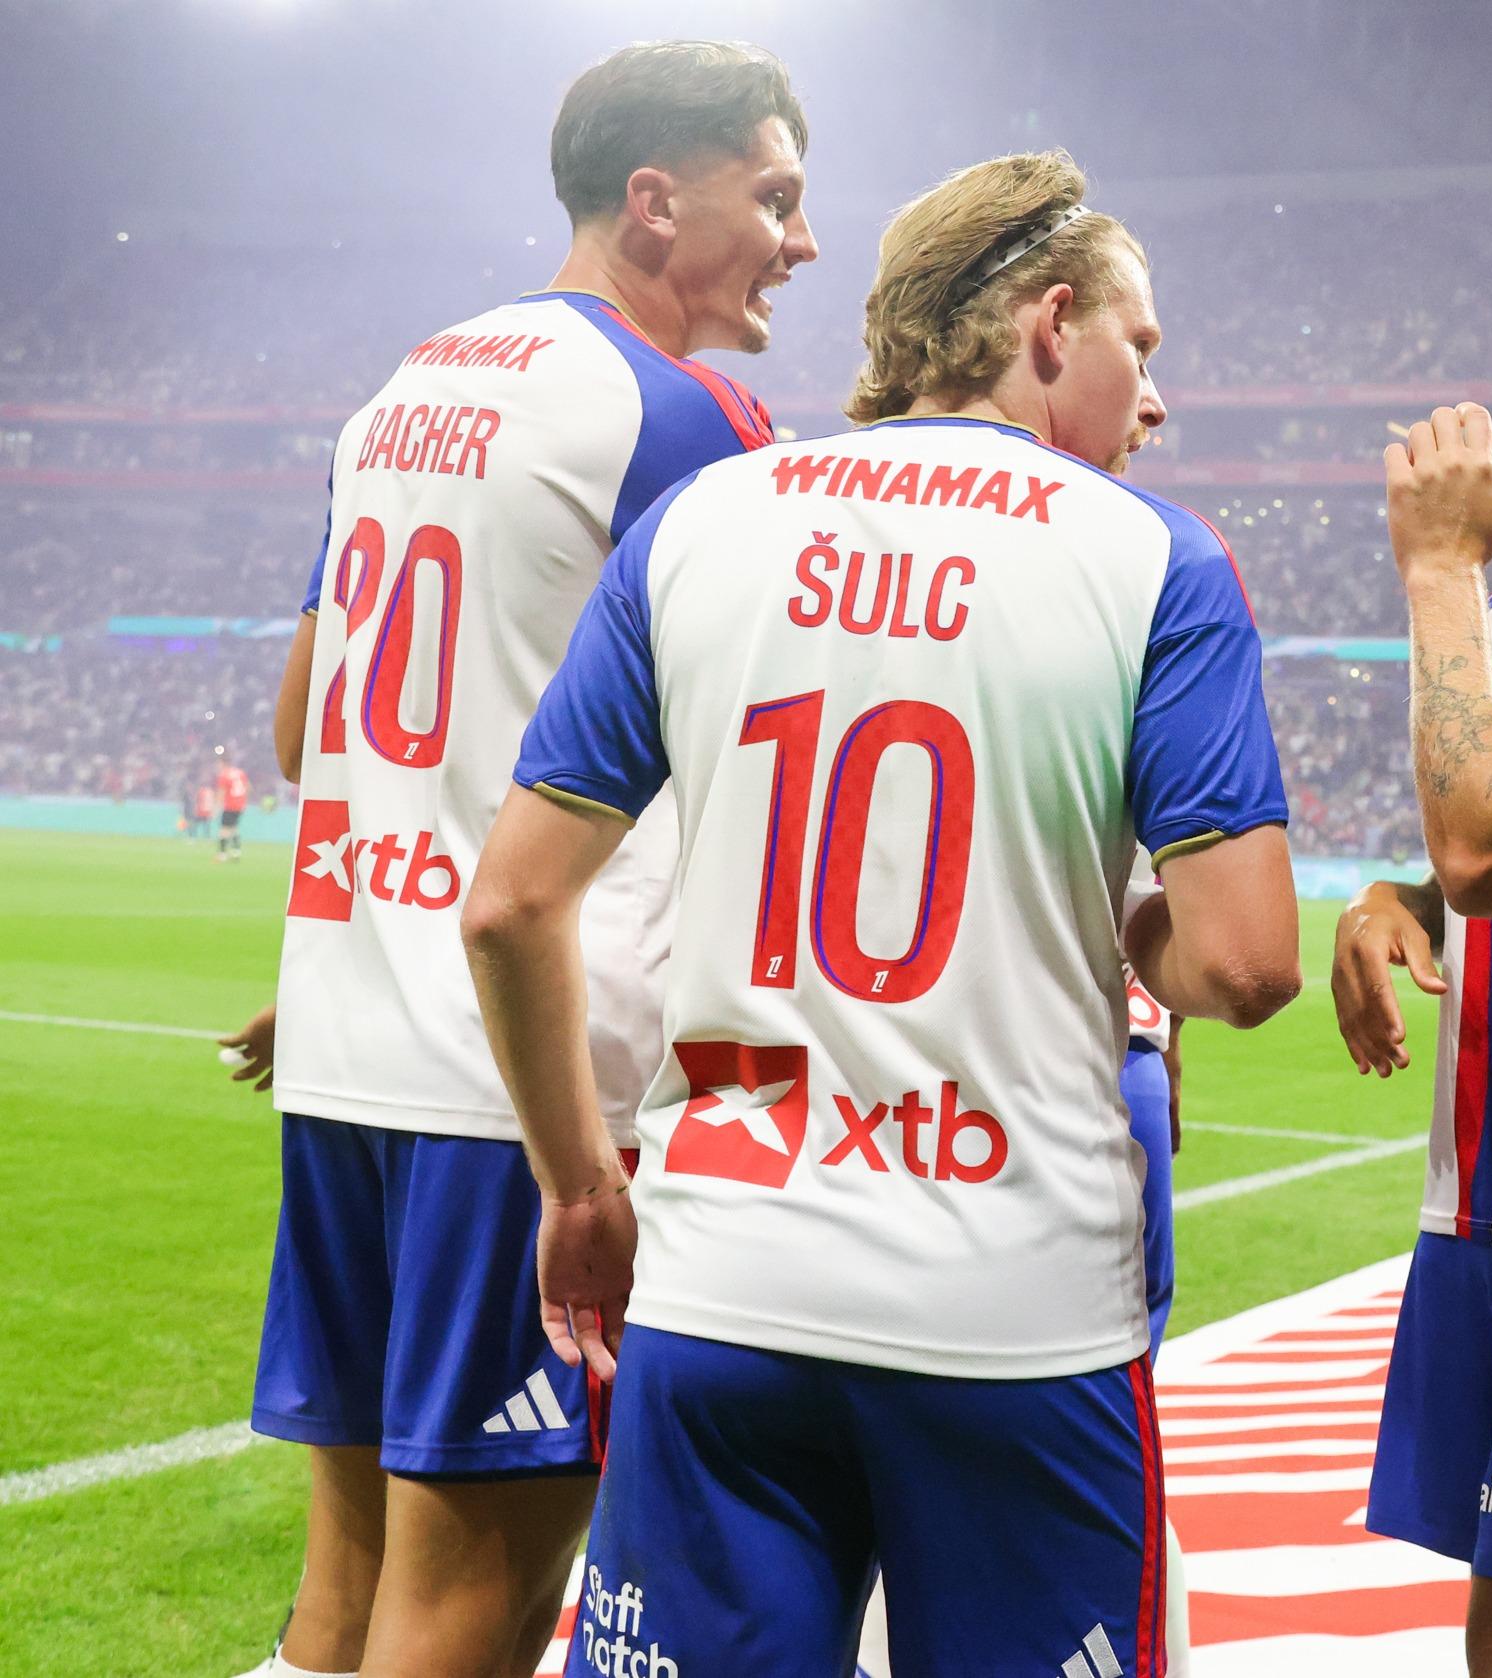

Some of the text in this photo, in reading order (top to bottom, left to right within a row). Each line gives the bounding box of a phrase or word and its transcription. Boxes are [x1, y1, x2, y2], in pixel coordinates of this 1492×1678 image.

[402, 334, 555, 372] WINAMAX
[356, 404, 501, 480] BACHER
[771, 455, 1066, 524] WINAMAX
[787, 531, 976, 641] ŠULC
[320, 517, 462, 768] 20
[738, 689, 975, 1003] 10
[820, 1081, 1008, 1183] xtb
